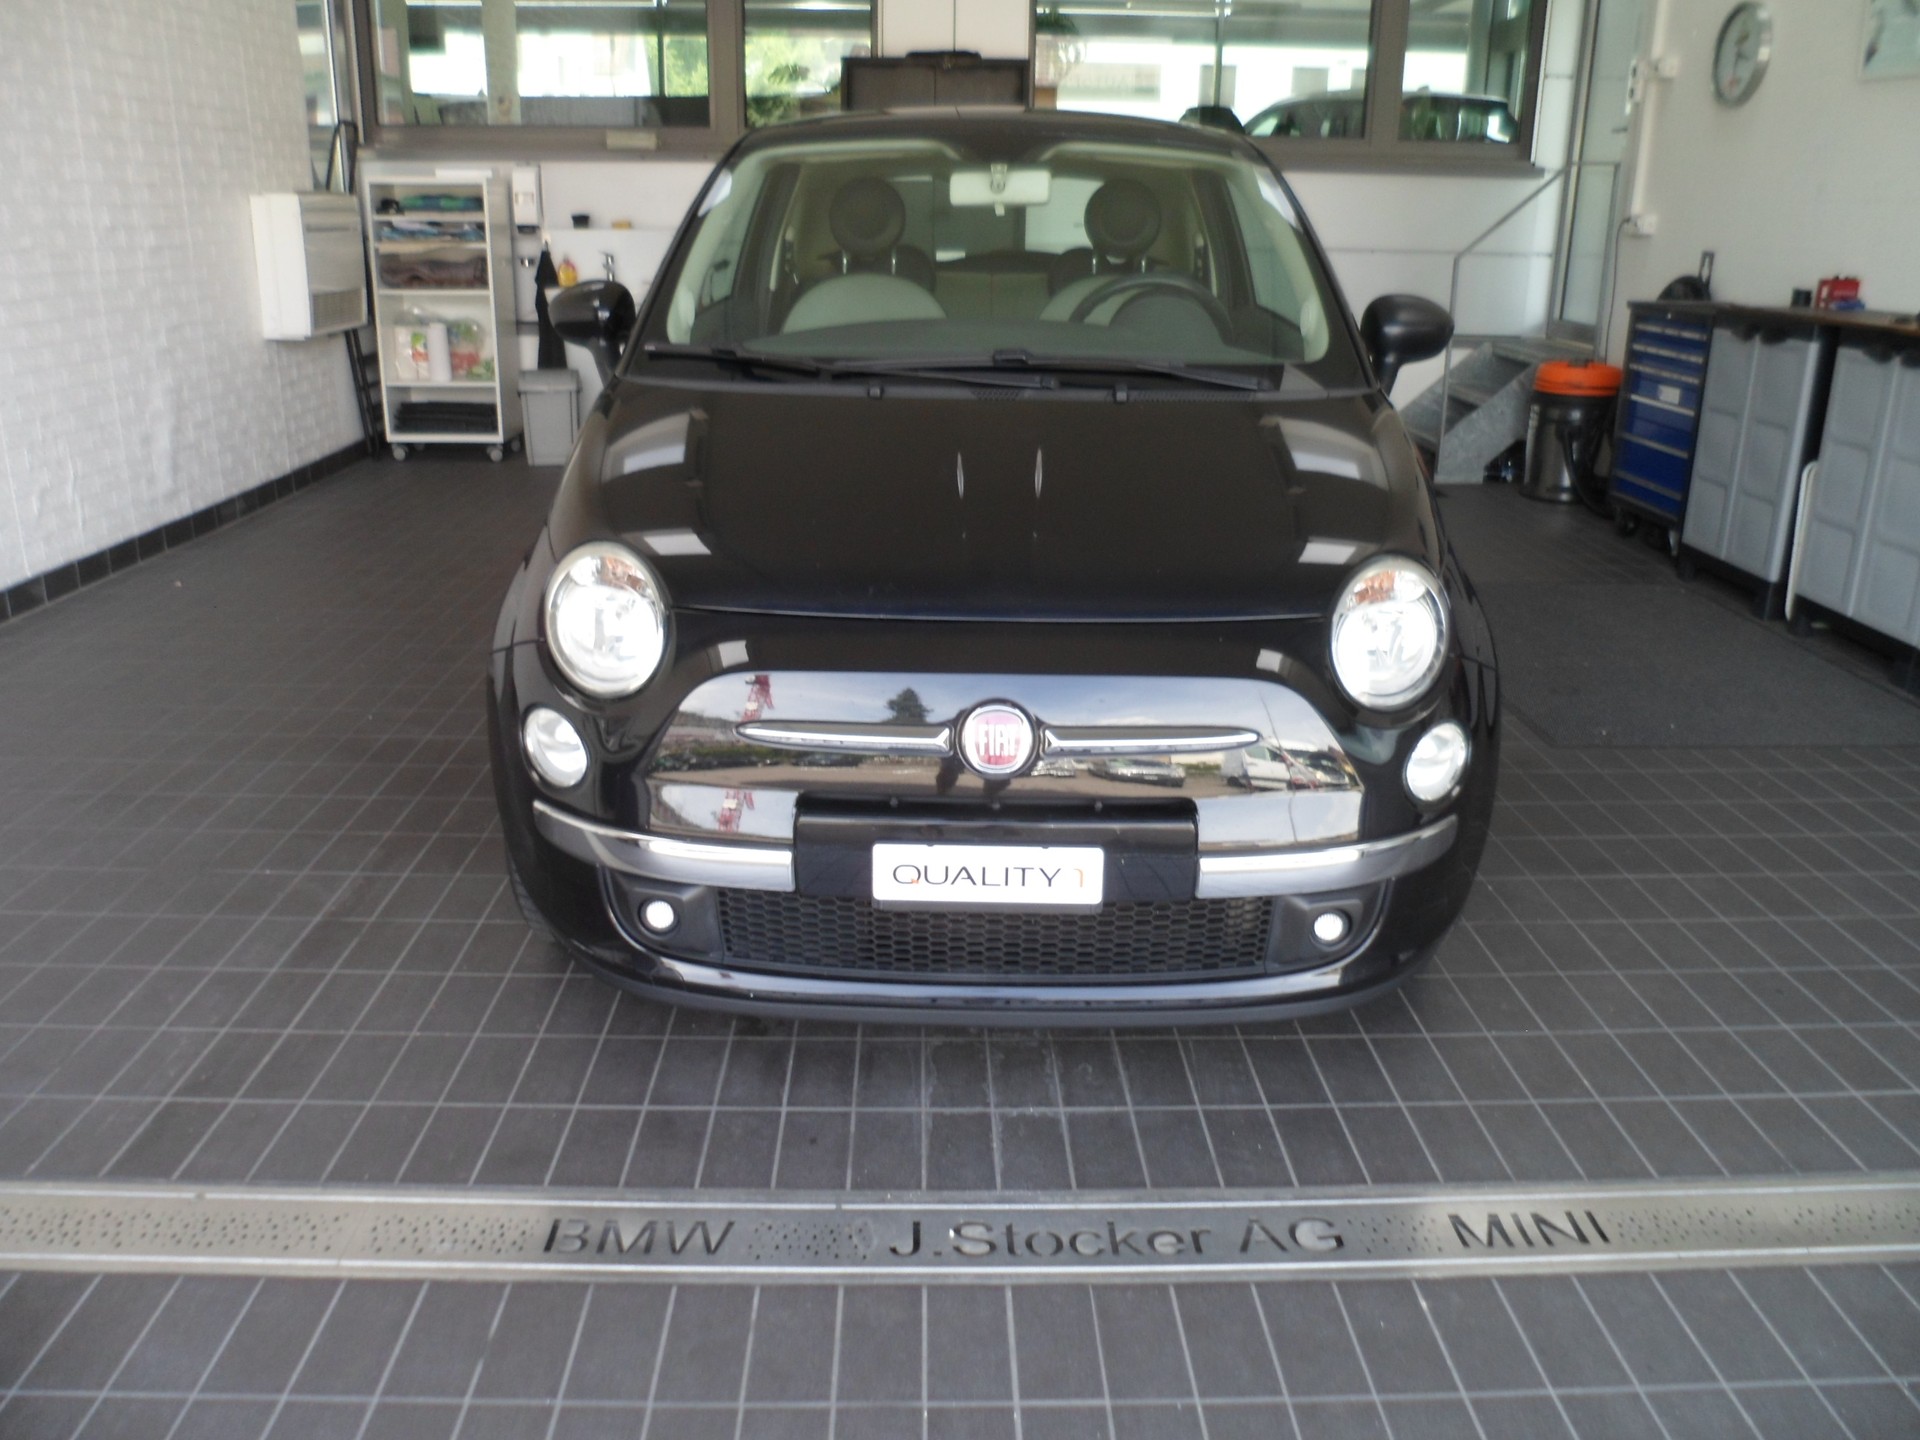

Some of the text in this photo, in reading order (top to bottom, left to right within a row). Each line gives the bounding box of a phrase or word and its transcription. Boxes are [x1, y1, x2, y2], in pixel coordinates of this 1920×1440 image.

[979, 725, 1018, 756] FIAT
[544, 1218, 735, 1256] BMW
[1239, 1217, 1344, 1254] AG
[1448, 1210, 1610, 1247] MINI
